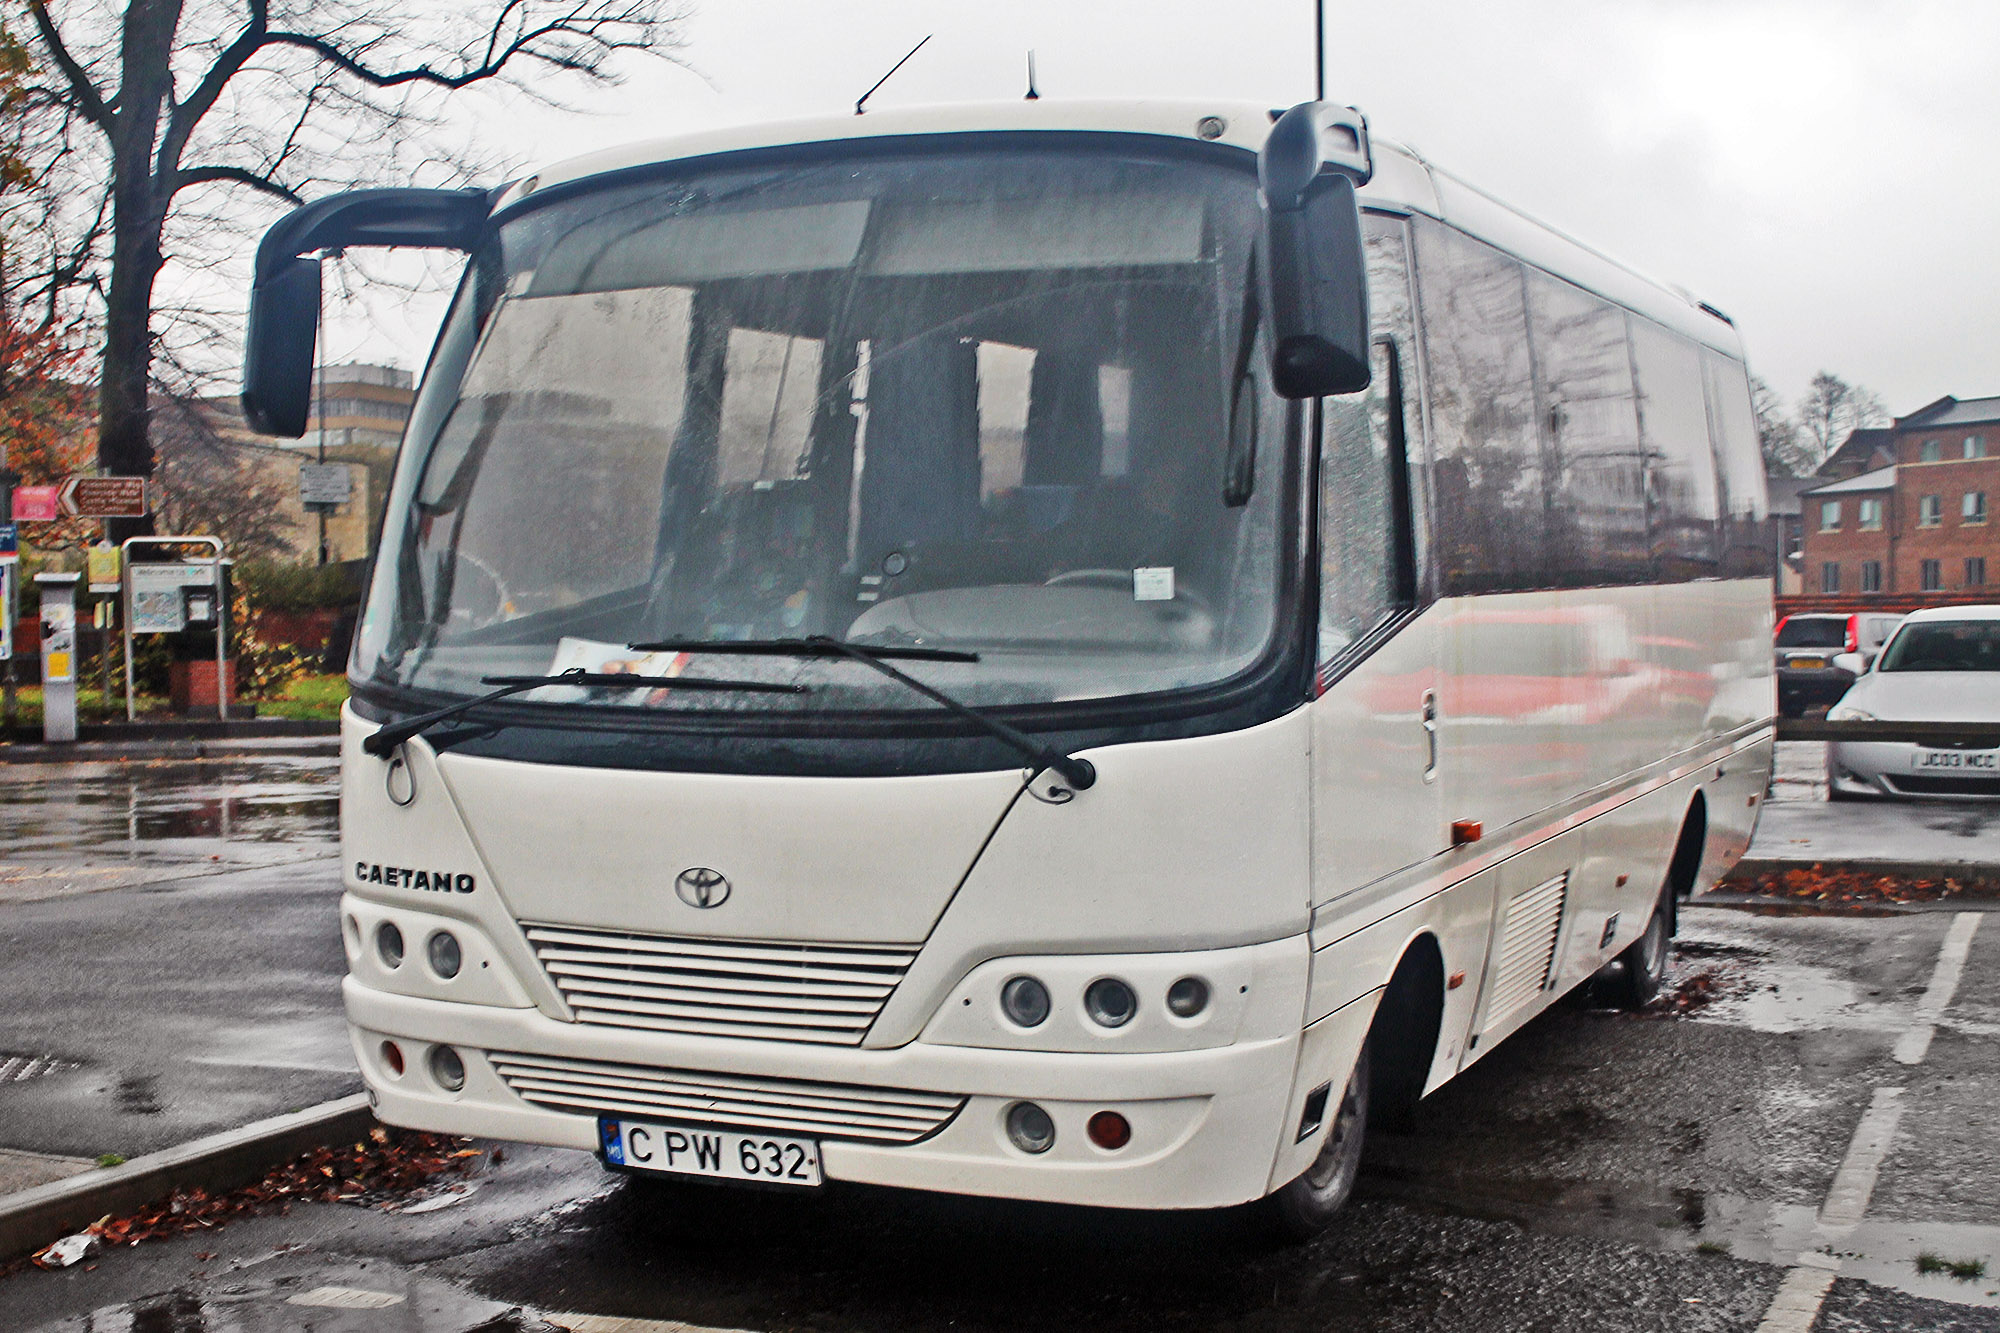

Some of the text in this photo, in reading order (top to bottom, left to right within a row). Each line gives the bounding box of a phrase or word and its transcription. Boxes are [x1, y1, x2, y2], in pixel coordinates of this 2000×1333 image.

[354, 861, 475, 894] CAETANO
[628, 1127, 808, 1180] C PW 632
